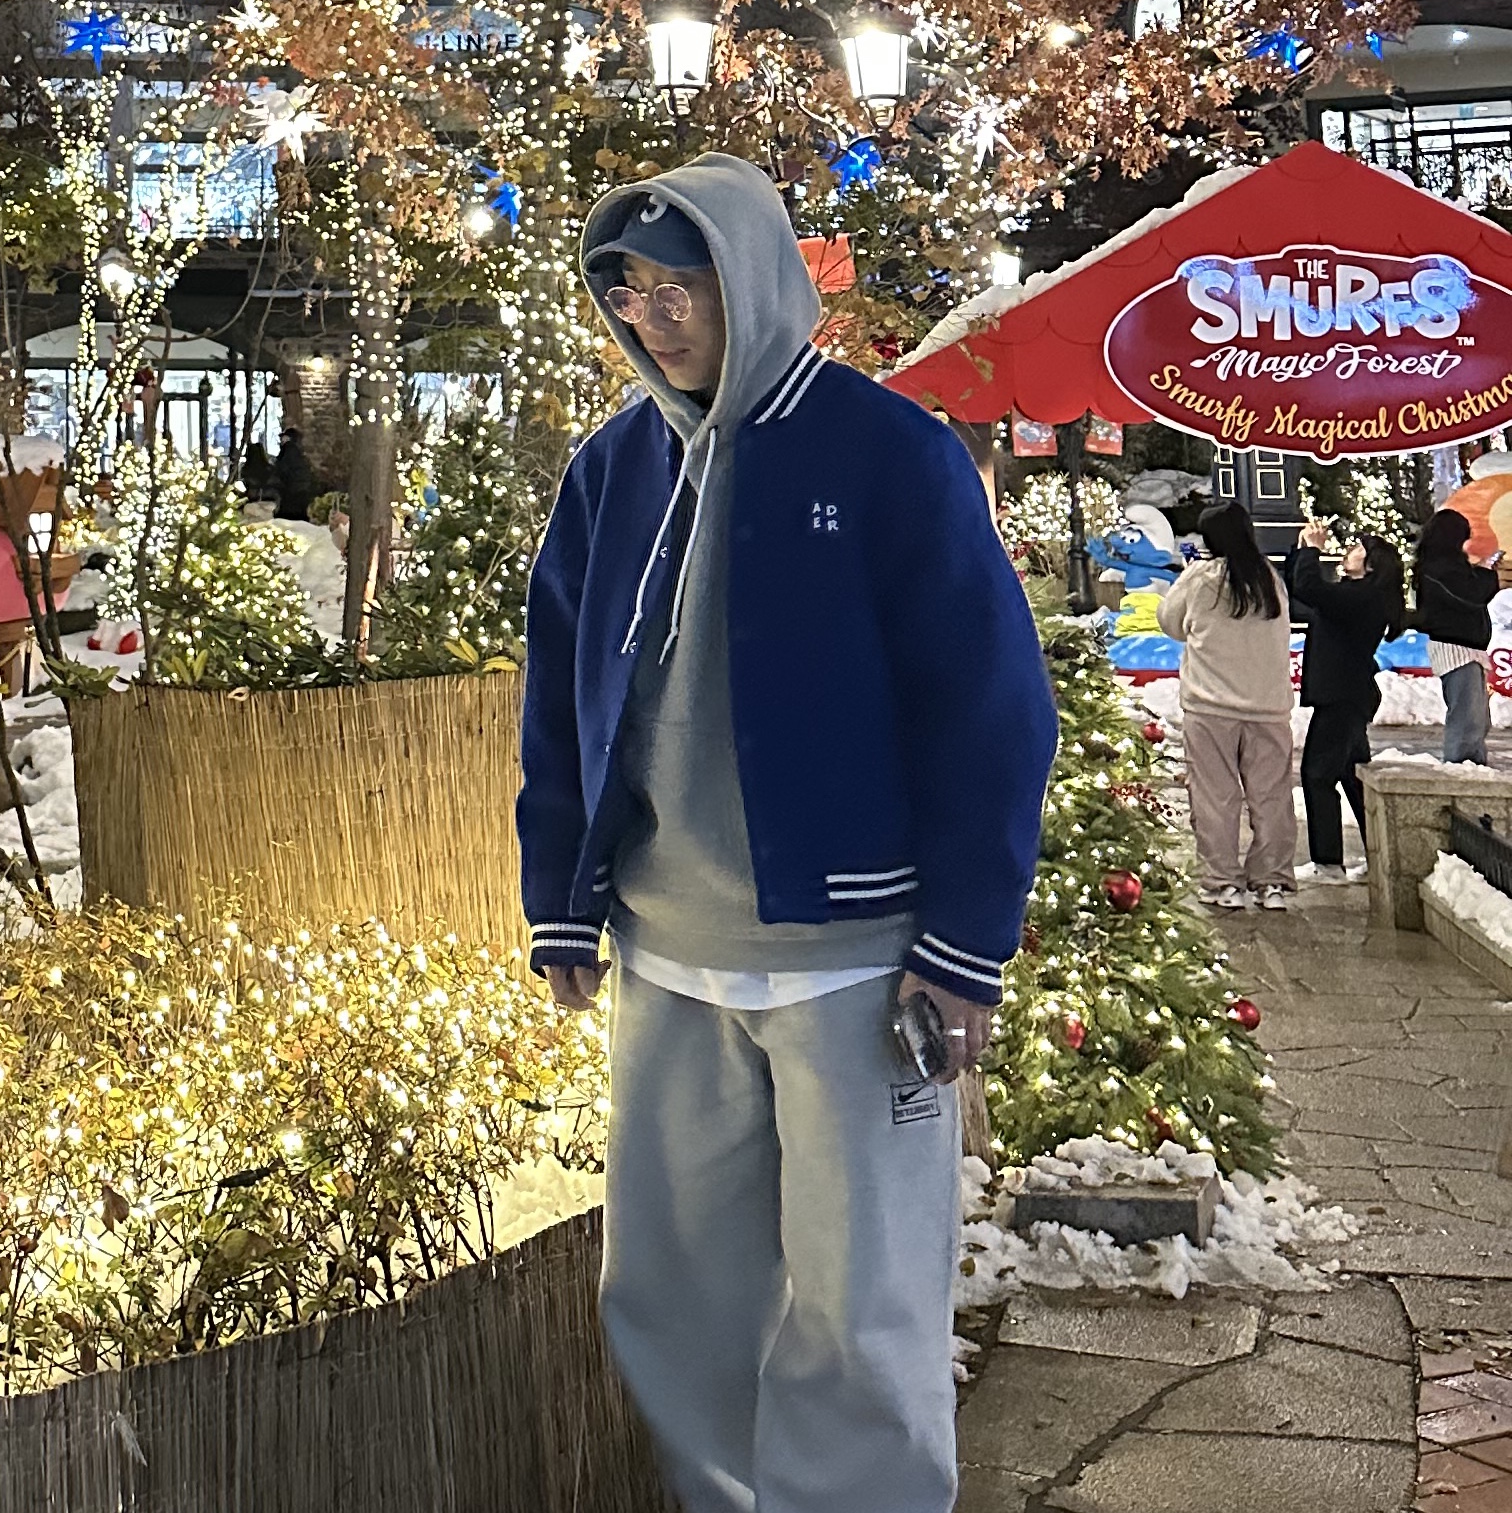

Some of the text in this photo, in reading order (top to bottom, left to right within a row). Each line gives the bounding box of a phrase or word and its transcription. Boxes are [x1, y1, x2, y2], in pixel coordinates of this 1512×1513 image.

[1294, 258, 1329, 280] THE
[1186, 264, 1461, 344] SMURFS
[1190, 342, 1462, 383] Magic Forest
[1149, 365, 1260, 442] Smurfy
[1264, 403, 1393, 454] Magical
